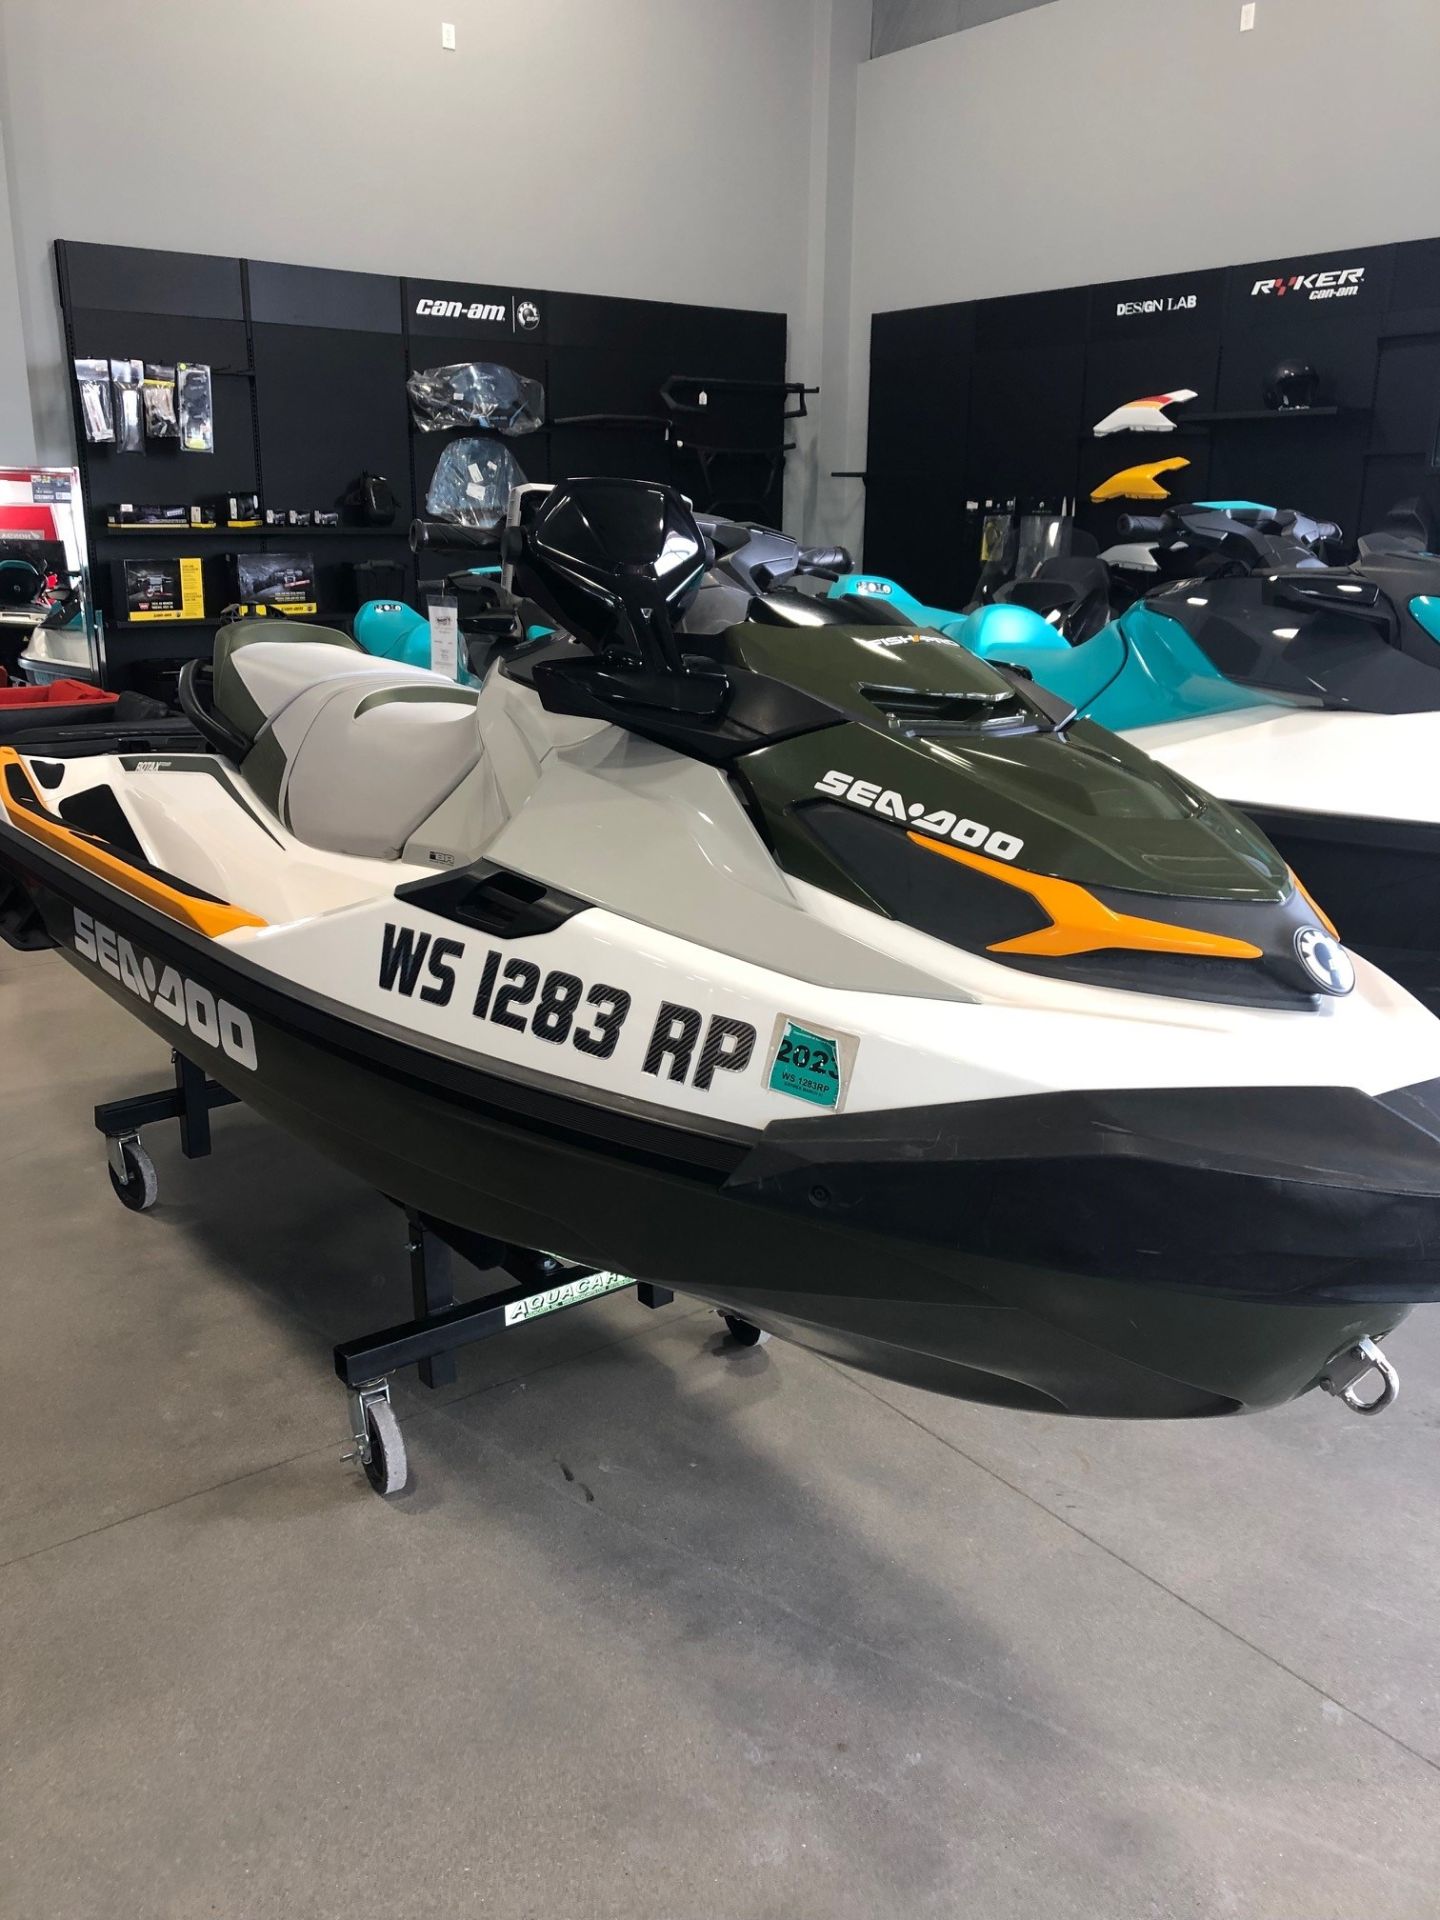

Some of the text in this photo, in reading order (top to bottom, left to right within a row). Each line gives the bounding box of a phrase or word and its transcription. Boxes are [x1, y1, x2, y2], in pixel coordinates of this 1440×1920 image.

[1251, 267, 1365, 296] RYKER
[1308, 285, 1358, 300] can-am
[415, 298, 506, 321] can-am
[1116, 295, 1197, 316] DESIGN LAB
[378, 922, 758, 1093] WS 1283 RP
[782, 1071, 830, 1093] WS 1283RP
[510, 1268, 634, 1319] AQUACAR
